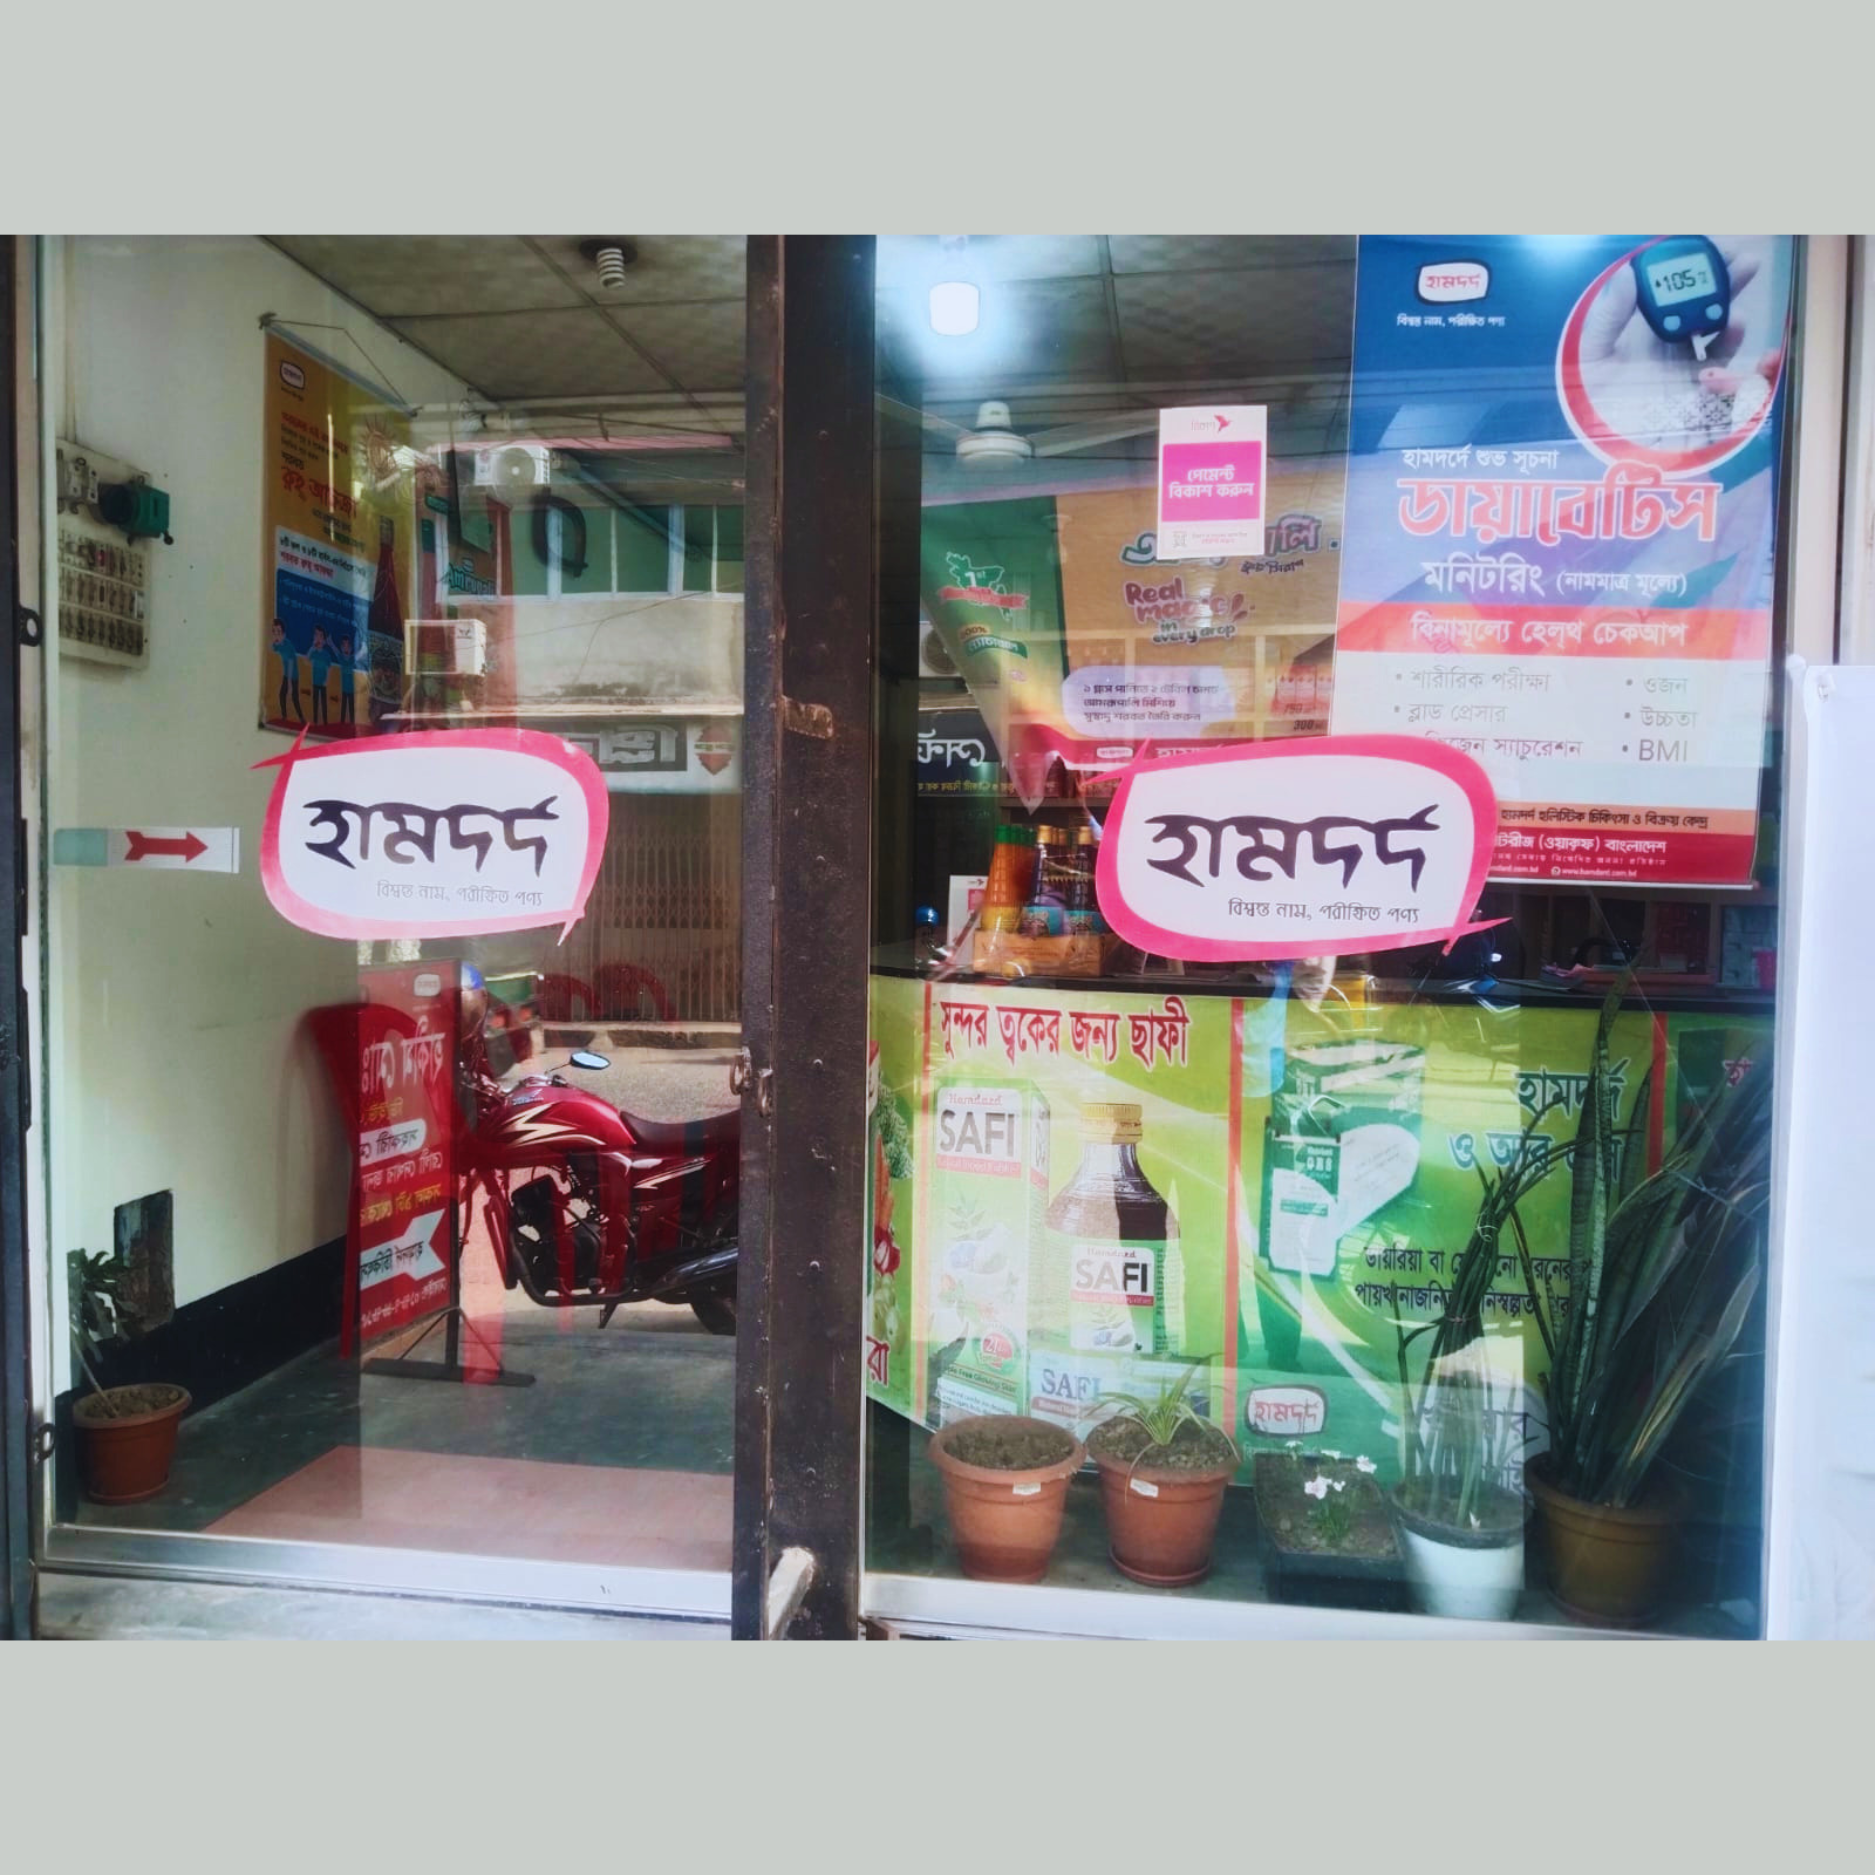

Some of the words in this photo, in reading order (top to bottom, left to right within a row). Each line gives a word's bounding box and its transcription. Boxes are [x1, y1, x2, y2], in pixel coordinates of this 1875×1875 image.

[1425, 273, 1481, 289] হামদর্দ
[1663, 268, 1697, 293] 105
[1402, 443, 1470, 468] হামদর্দে
[1476, 448, 1505, 468] শুভ
[1513, 449, 1559, 475] সূচনা
[1187, 464, 1235, 482] পেমেন্ট
[1168, 482, 1213, 498] বিকাশ
[1216, 483, 1254, 498] করুন
[1396, 458, 1724, 547] ডায়াবেটিস
[1421, 551, 1545, 597] মনিটরিং
[1556, 570, 1628, 595] (নামমাত্র
[1635, 572, 1687, 597] মূল্যে)
[1125, 577, 1182, 604] Real
[1153, 629, 1198, 644] every
[1200, 623, 1236, 639] drop
[1160, 619, 1177, 632] in
[1409, 610, 1514, 647] বিনামূল্যে
[1593, 621, 1689, 647] চেকআপ
[1411, 665, 1484, 691] শারীরিক
[1491, 666, 1552, 692] পরীক্ষা
[1643, 677, 1688, 694] ওজন
[1408, 702, 1444, 723] ব্লাড
[1449, 703, 1509, 723] প্রেসার
[1640, 705, 1697, 727] উচ্চতা
[1493, 736, 1585, 761] স্যাচুরেশন
[1638, 739, 1688, 762] BMI
[303, 795, 560, 877] হামদর্দ
[1144, 803, 1441, 893] হামদর্দ
[1604, 838, 1667, 854] বাংলাদেশ
[377, 880, 413, 899] বিশ্বস্ত
[457, 885, 510, 905] পরীক্ষিত
[514, 890, 544, 907] পণ্য
[1228, 897, 1270, 917] বিশ্বস্ত
[1276, 902, 1311, 922] নাম,
[1319, 902, 1381, 922] পরীক্ষিত
[1387, 907, 1420, 924] পণ্য
[939, 1000, 990, 1060] সুন্দর
[995, 1005, 1063, 1067] ত্বকের
[1068, 1009, 1121, 1063] জন্য
[1127, 994, 1192, 1072] ছাফী
[948, 1093, 1003, 1107] Hamdard
[938, 1108, 1016, 1158] SAFI
[1452, 1133, 1476, 1170] ও
[1364, 1242, 1422, 1273] ডায়রিয়া
[1427, 1249, 1445, 1275] বা
[1076, 1259, 1148, 1293] SAFI
[1041, 1368, 1102, 1402] SAFI
[1254, 1397, 1320, 1425] হামদর্দ
